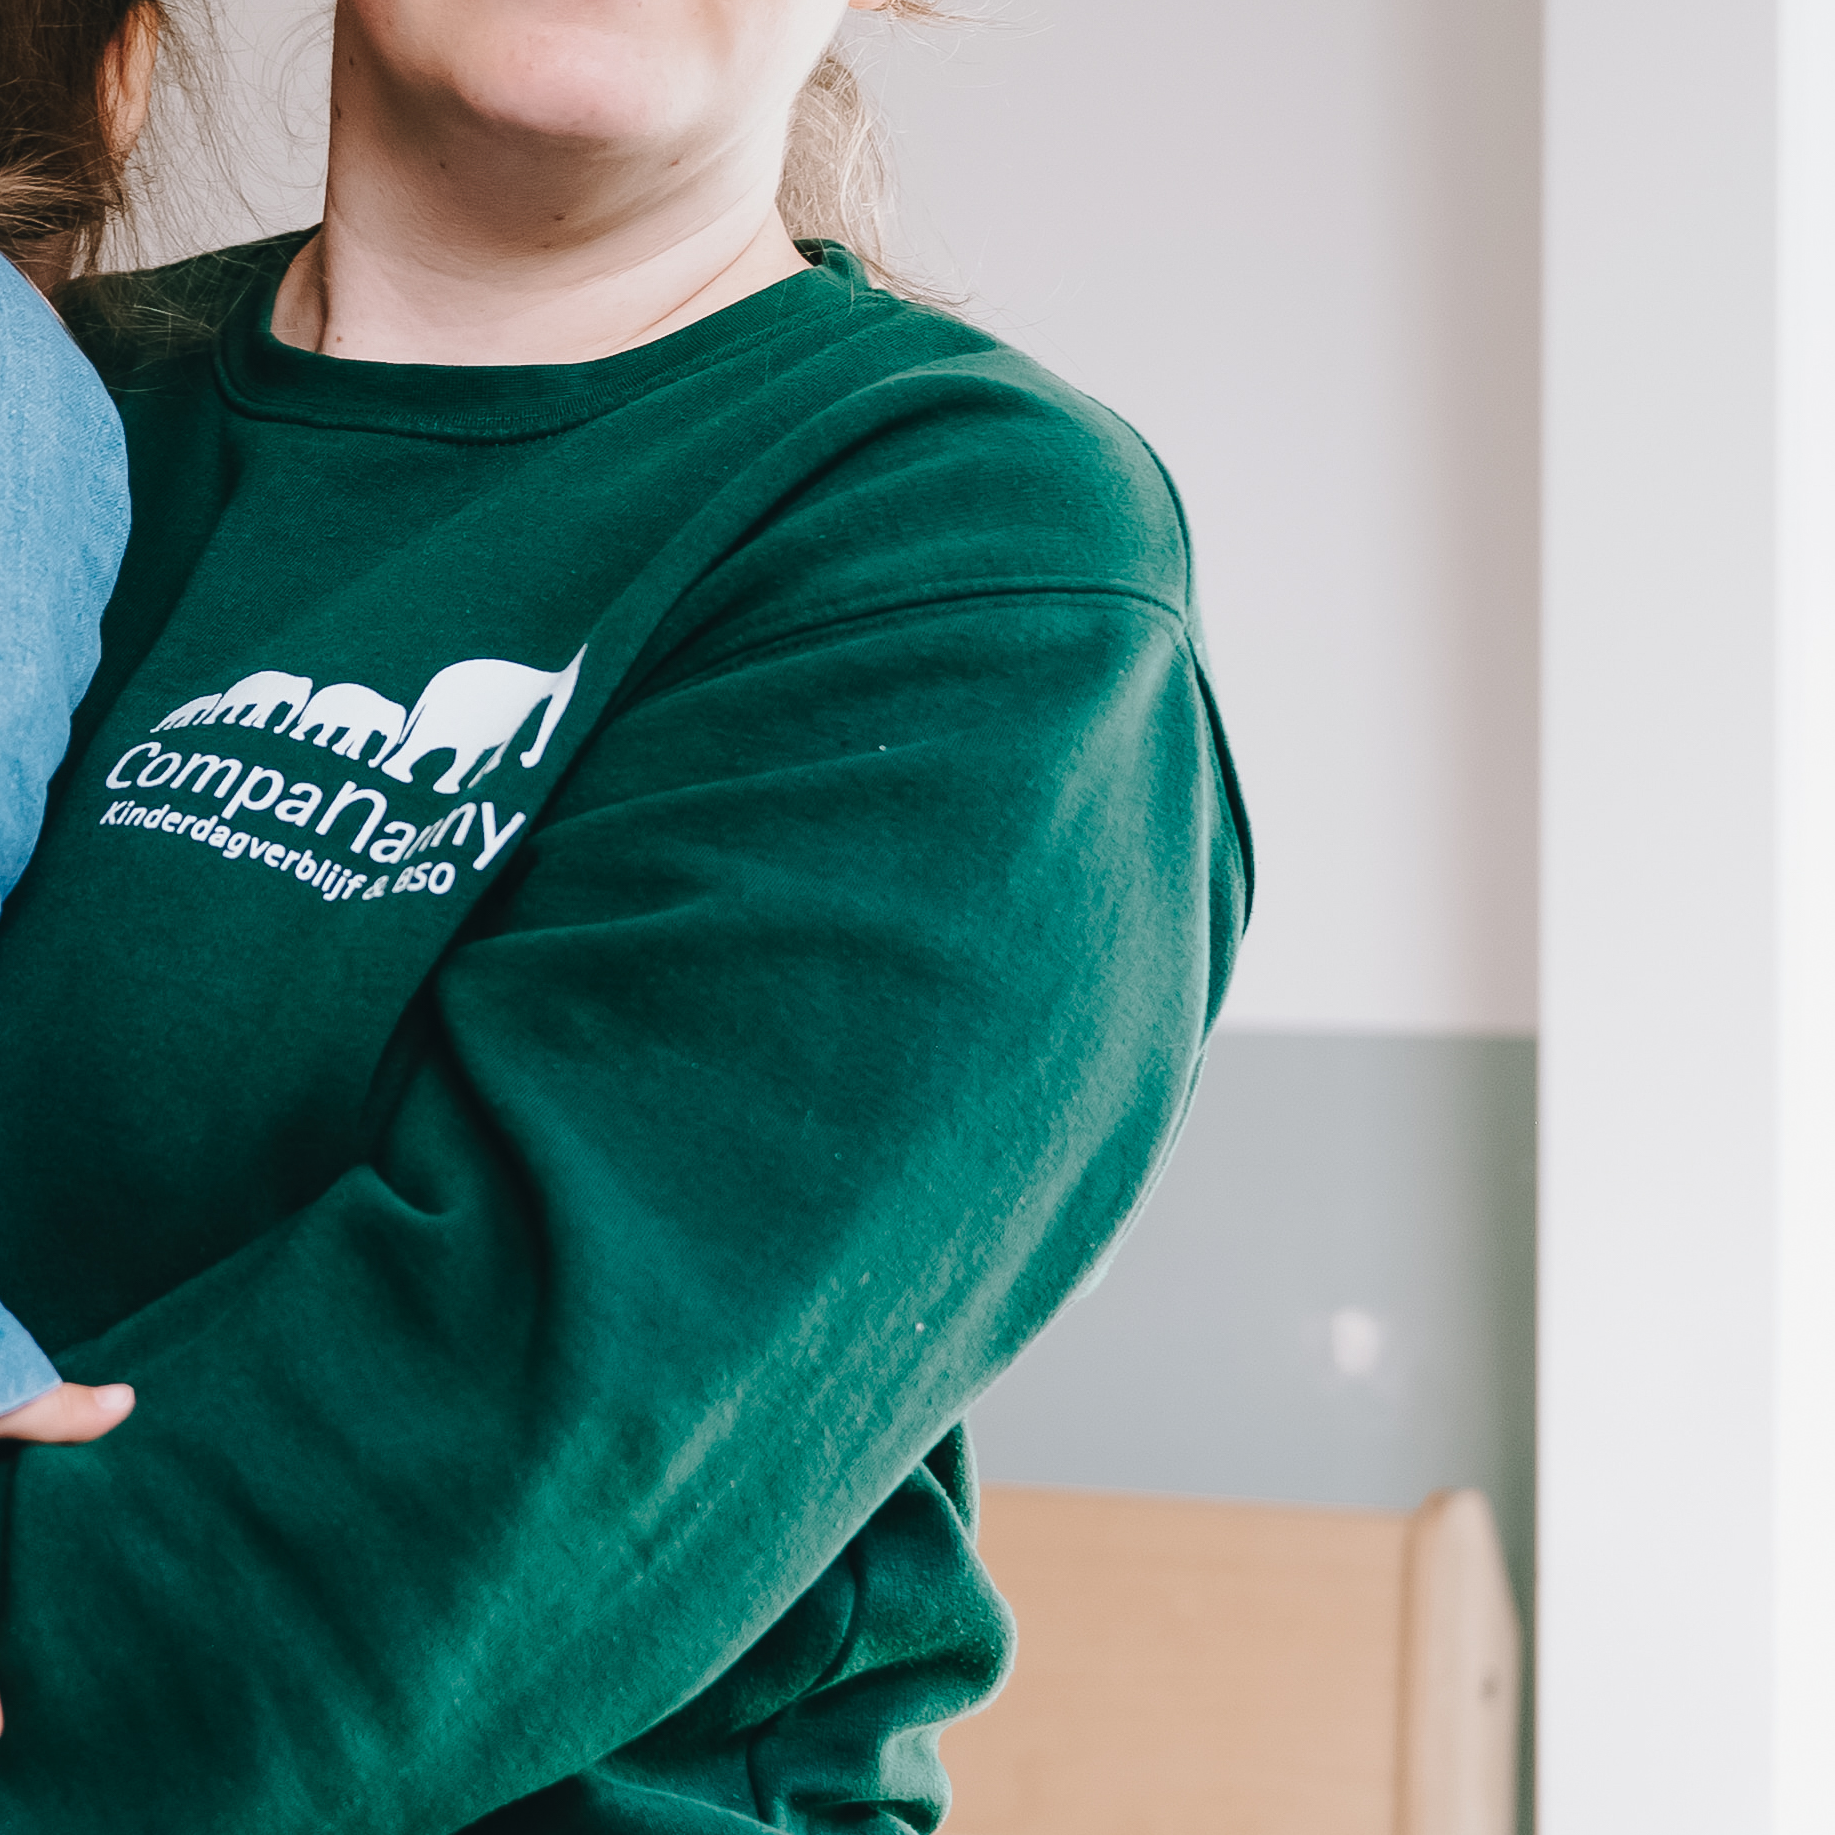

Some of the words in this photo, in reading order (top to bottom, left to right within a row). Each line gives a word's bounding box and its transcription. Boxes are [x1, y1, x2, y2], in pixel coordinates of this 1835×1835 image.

[99, 800, 368, 902] Kinderdagverblijf
[361, 874, 390, 901] &
[391, 861, 457, 895] BSO
